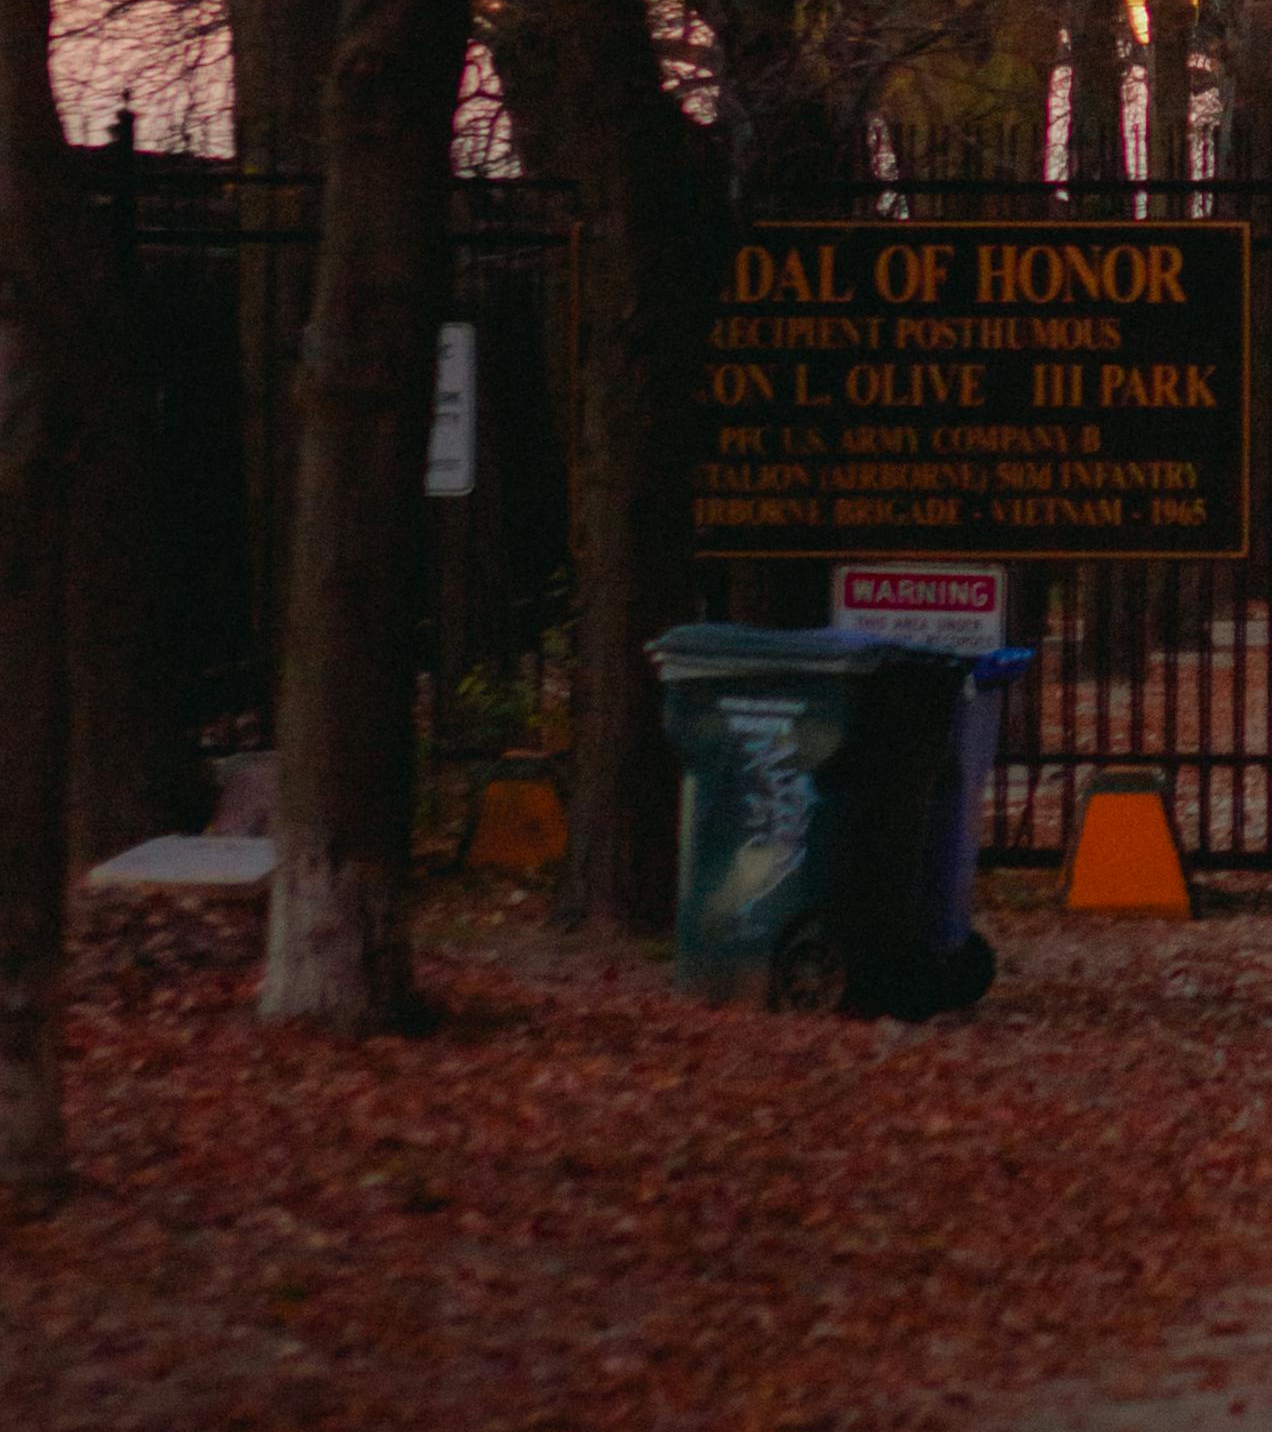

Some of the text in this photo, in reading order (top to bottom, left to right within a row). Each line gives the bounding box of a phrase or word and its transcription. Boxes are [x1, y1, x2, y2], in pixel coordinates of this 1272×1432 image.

[722, 242, 1189, 305] DAL OF HONOR
[894, 315, 1122, 352] POSTHUMOUS
[697, 362, 778, 409] ON
[843, 362, 988, 409] OLIVE
[1031, 361, 1085, 409] III
[1098, 361, 1218, 409] PARK
[718, 424, 770, 455] PFC
[841, 424, 920, 455] ARMY
[931, 424, 1070, 454] COMPANY
[1060, 459, 1199, 491] INFANTRY
[832, 498, 961, 528] BRIGADE
[991, 497, 1122, 527] VIETNAM
[850, 576, 990, 609] WARNING
